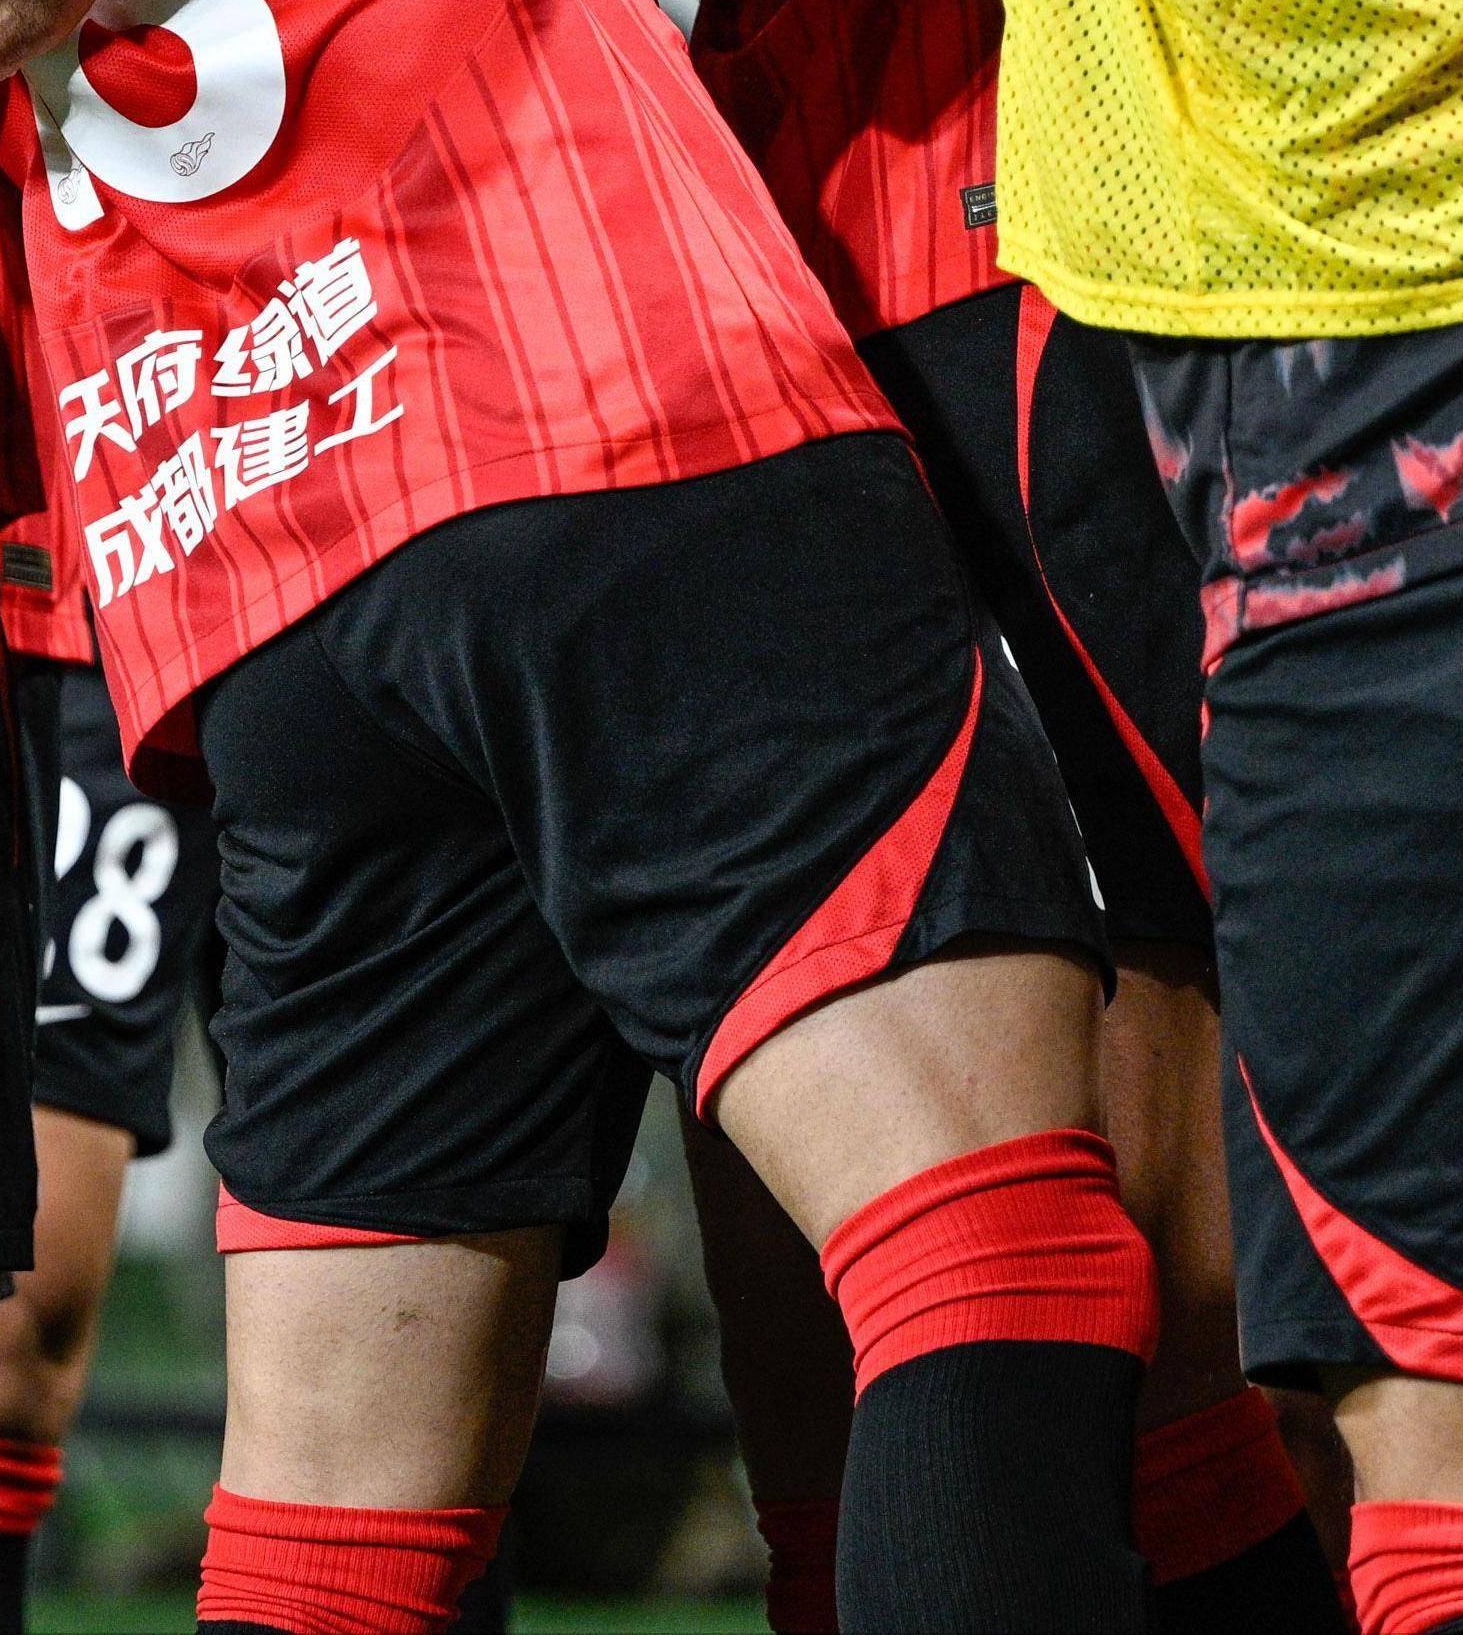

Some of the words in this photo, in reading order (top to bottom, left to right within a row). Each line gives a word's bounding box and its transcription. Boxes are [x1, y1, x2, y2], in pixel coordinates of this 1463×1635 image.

[58, 236, 379, 483] 天府绿道
[83, 346, 405, 609] 成都建工
